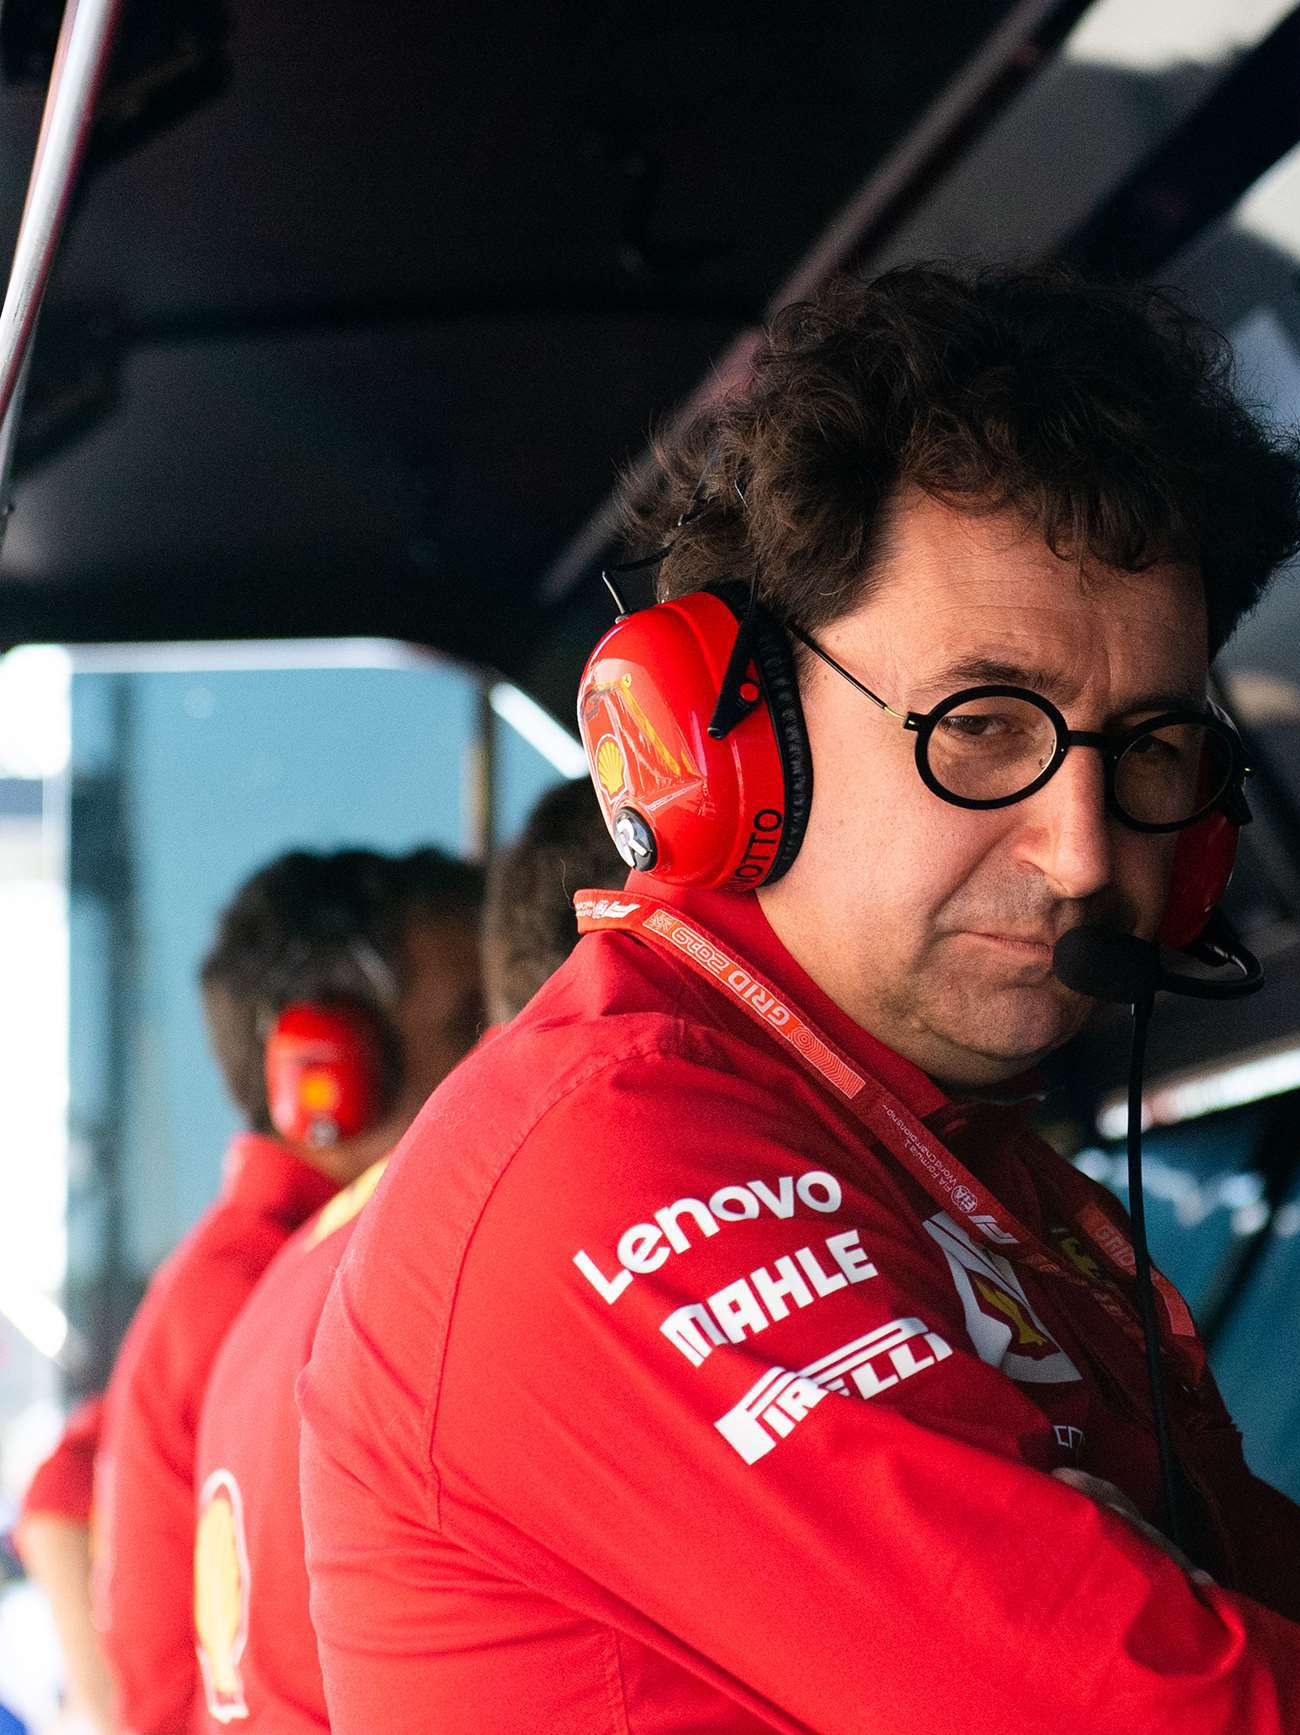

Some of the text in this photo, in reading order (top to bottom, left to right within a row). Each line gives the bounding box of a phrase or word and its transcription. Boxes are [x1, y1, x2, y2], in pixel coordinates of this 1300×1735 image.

[671, 927, 790, 1026] GRID 2019
[910, 1146, 940, 1178] Formula
[935, 1160, 957, 1186] World
[572, 1171, 842, 1305] Lenovo
[659, 1229, 878, 1368] MAHLE
